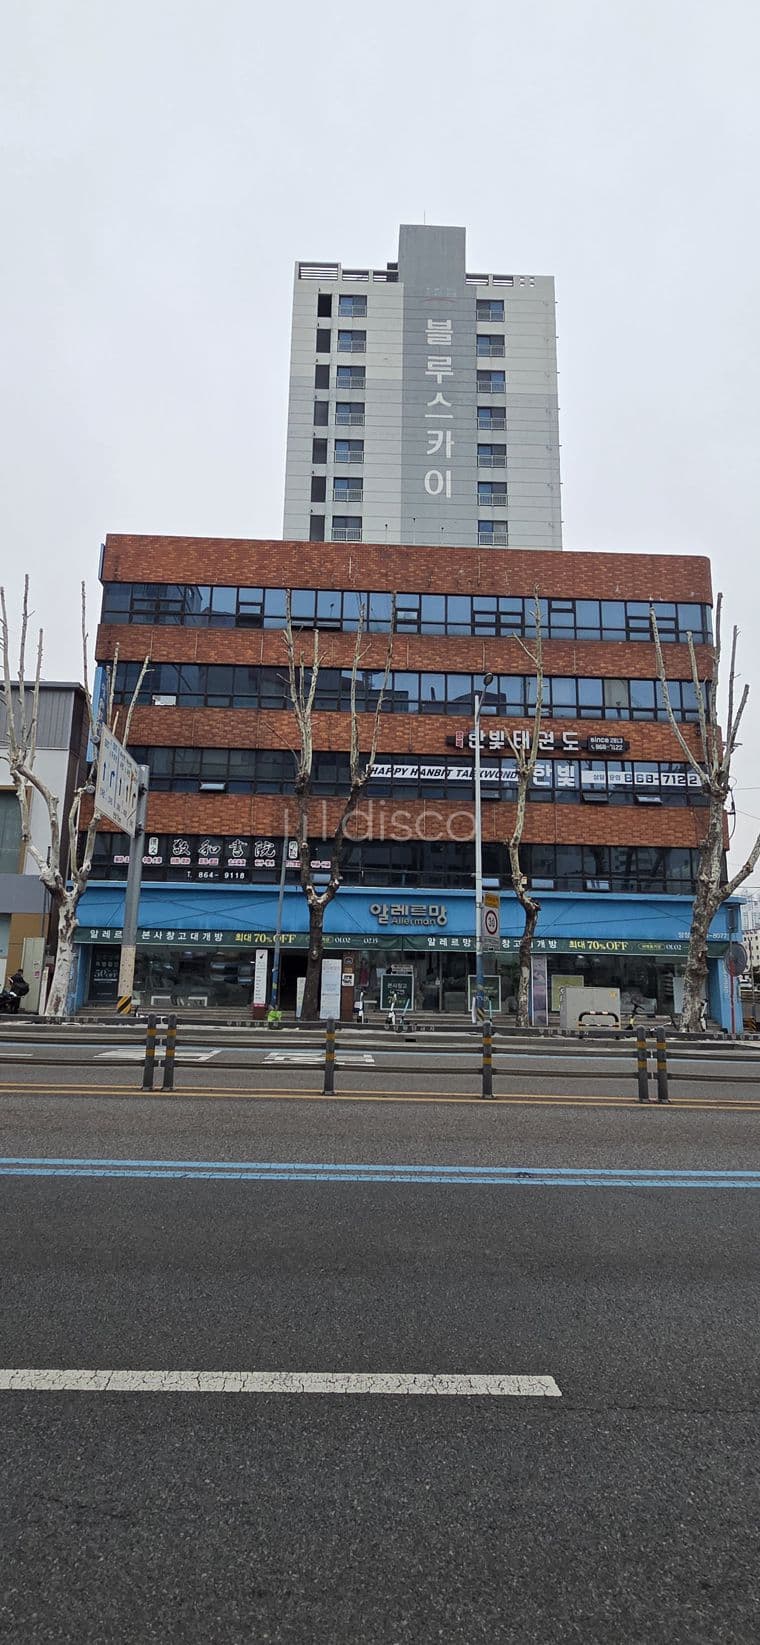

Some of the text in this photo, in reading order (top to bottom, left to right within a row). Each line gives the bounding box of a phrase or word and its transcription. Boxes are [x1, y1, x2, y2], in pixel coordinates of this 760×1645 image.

[424, 319, 454, 498] 블루스카이
[371, 766, 519, 780] HAPPY HANBIT TAEKWOND
[533, 764, 576, 787] 한빛
[370, 904, 448, 925] 알레르망
[90, 929, 123, 939] 알레르
